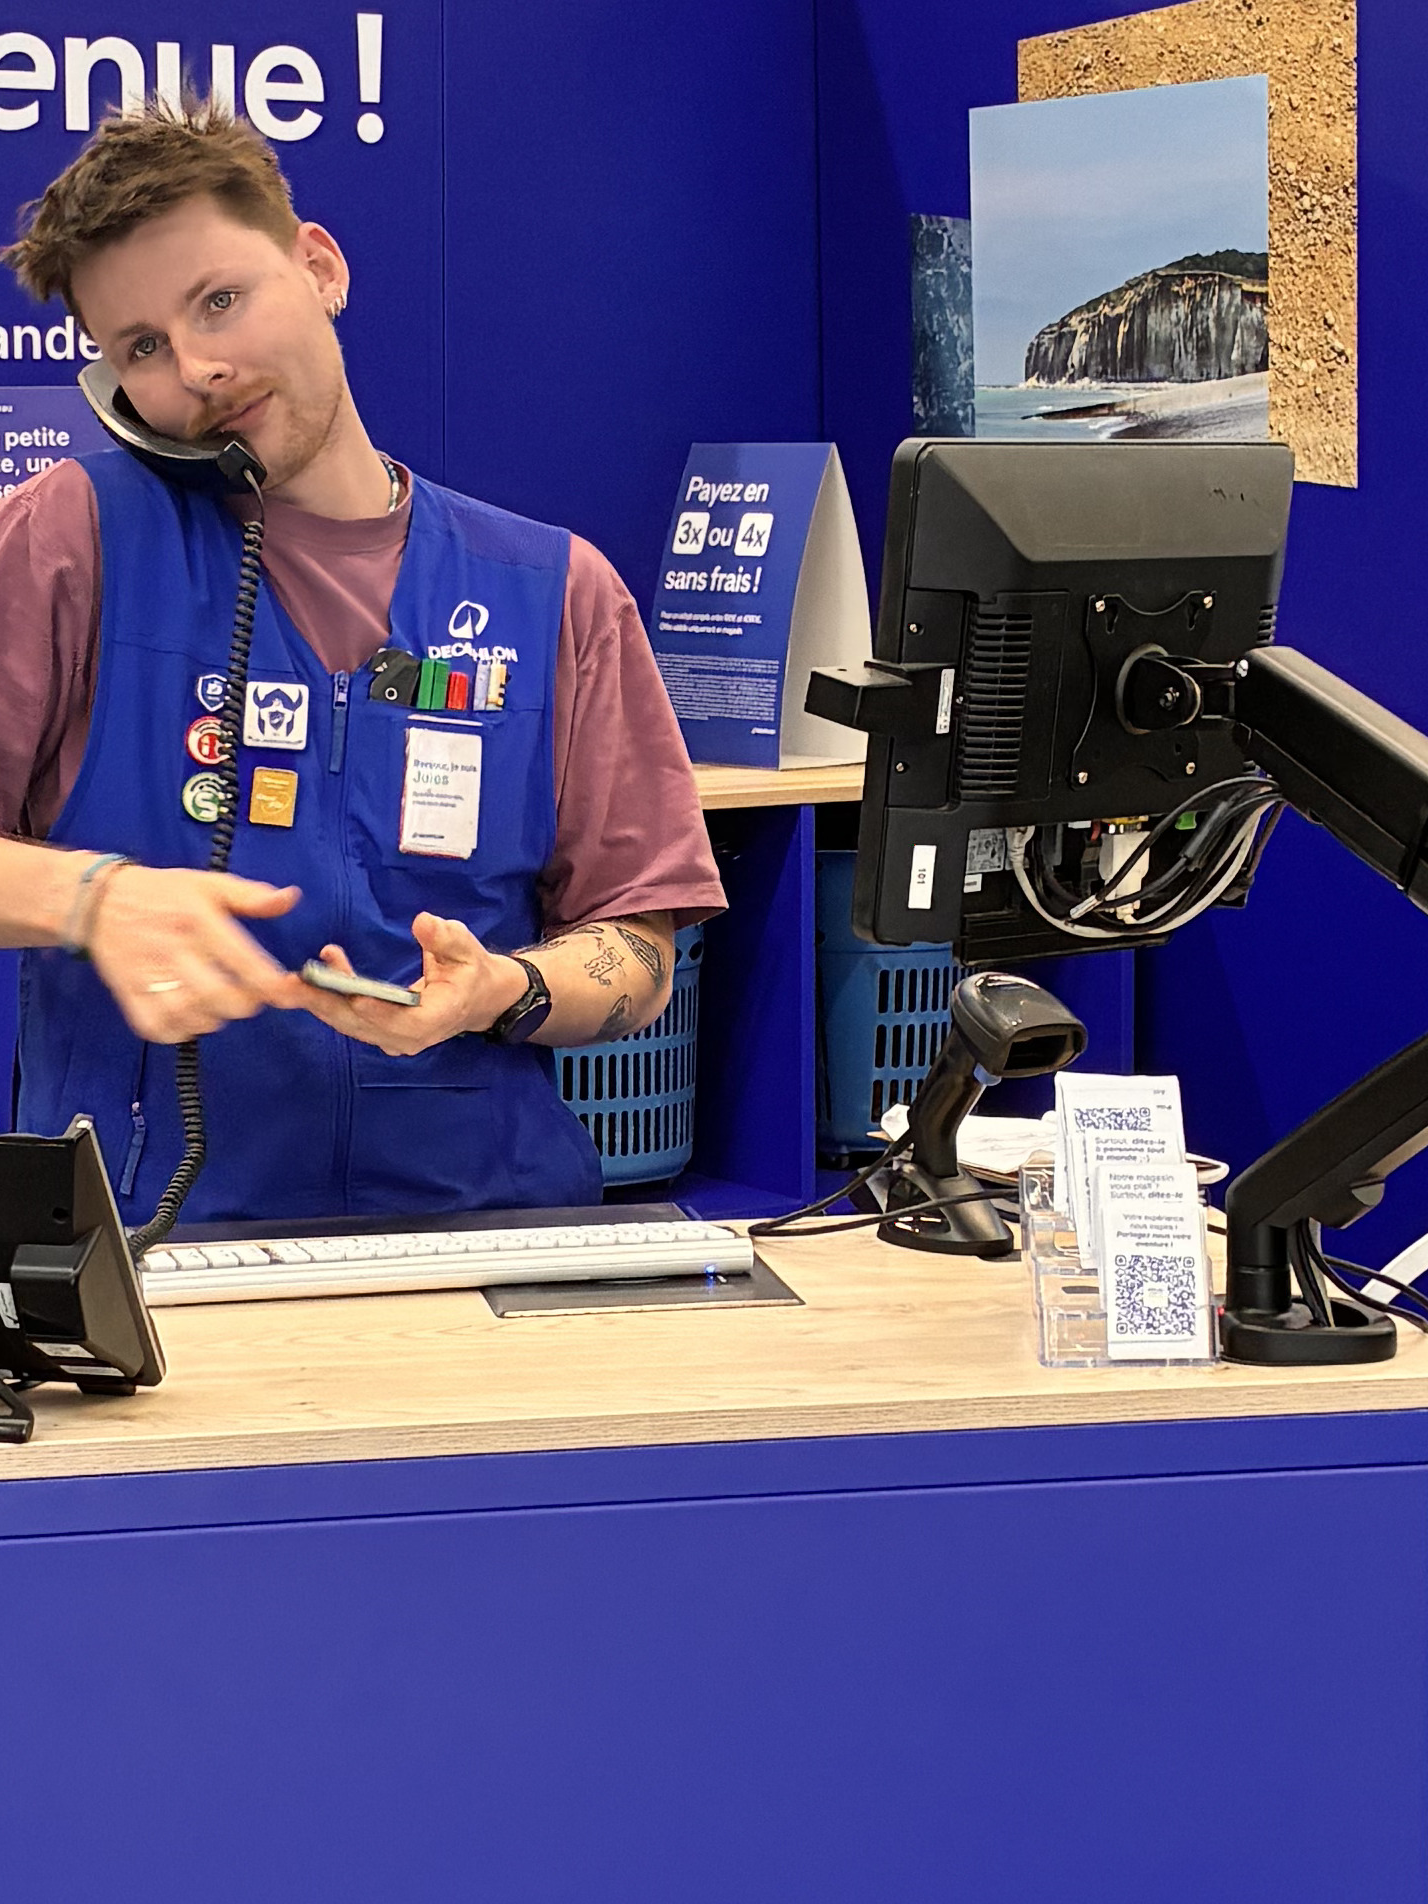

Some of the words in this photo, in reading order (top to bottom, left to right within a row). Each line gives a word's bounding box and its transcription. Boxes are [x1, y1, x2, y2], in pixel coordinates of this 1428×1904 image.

[4, 426, 70, 452] petite
[685, 476, 744, 508] Payez
[743, 483, 770, 503] en
[678, 520, 703, 545] 3x
[708, 527, 734, 547] ou
[741, 522, 766, 548] 4x
[664, 570, 708, 592] sans
[710, 565, 752, 593] frais
